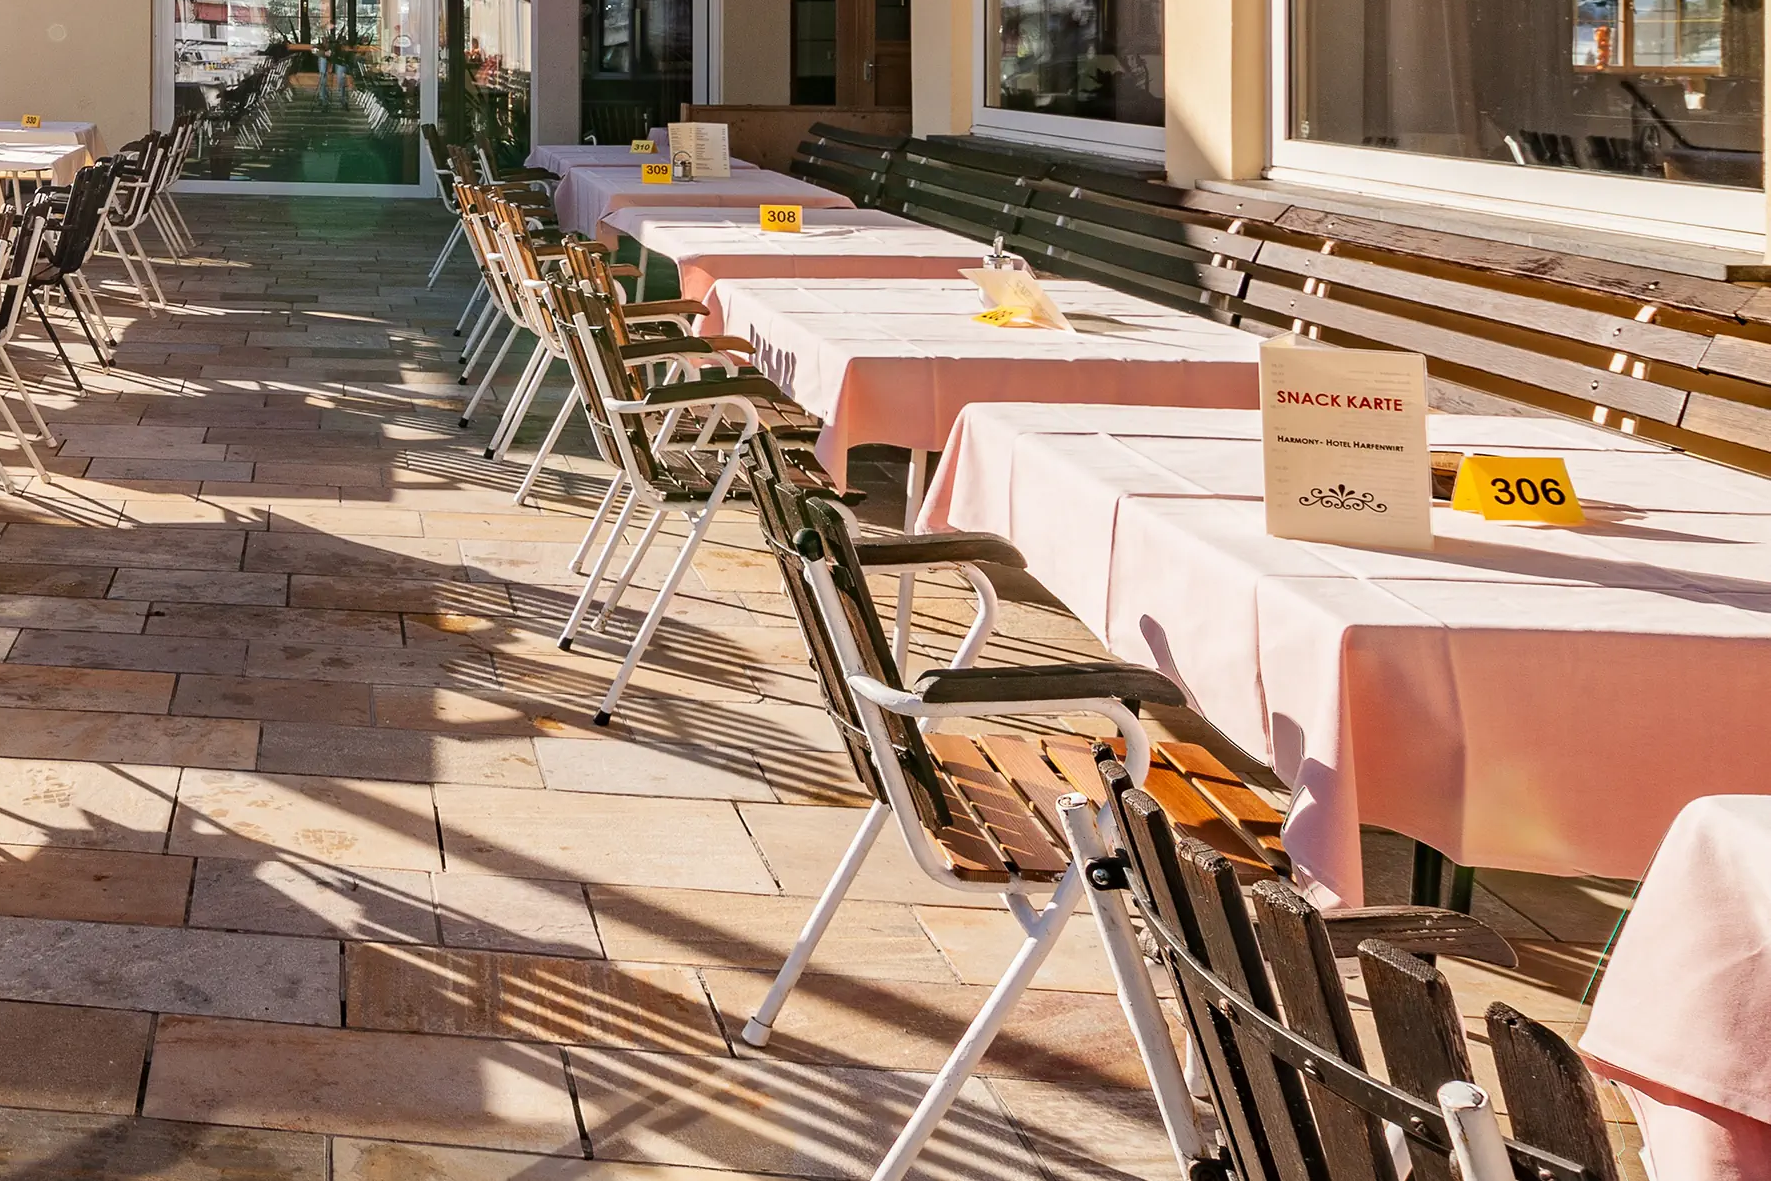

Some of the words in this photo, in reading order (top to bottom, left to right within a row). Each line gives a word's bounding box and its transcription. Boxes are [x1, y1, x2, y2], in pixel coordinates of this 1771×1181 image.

[634, 143, 650, 151] 310
[646, 164, 668, 175] 309
[767, 210, 796, 224] 308
[1276, 390, 1342, 408] SNACK
[1346, 395, 1403, 412] KARTE
[1325, 439, 1352, 449] HOTEL
[1490, 477, 1566, 506] 306
